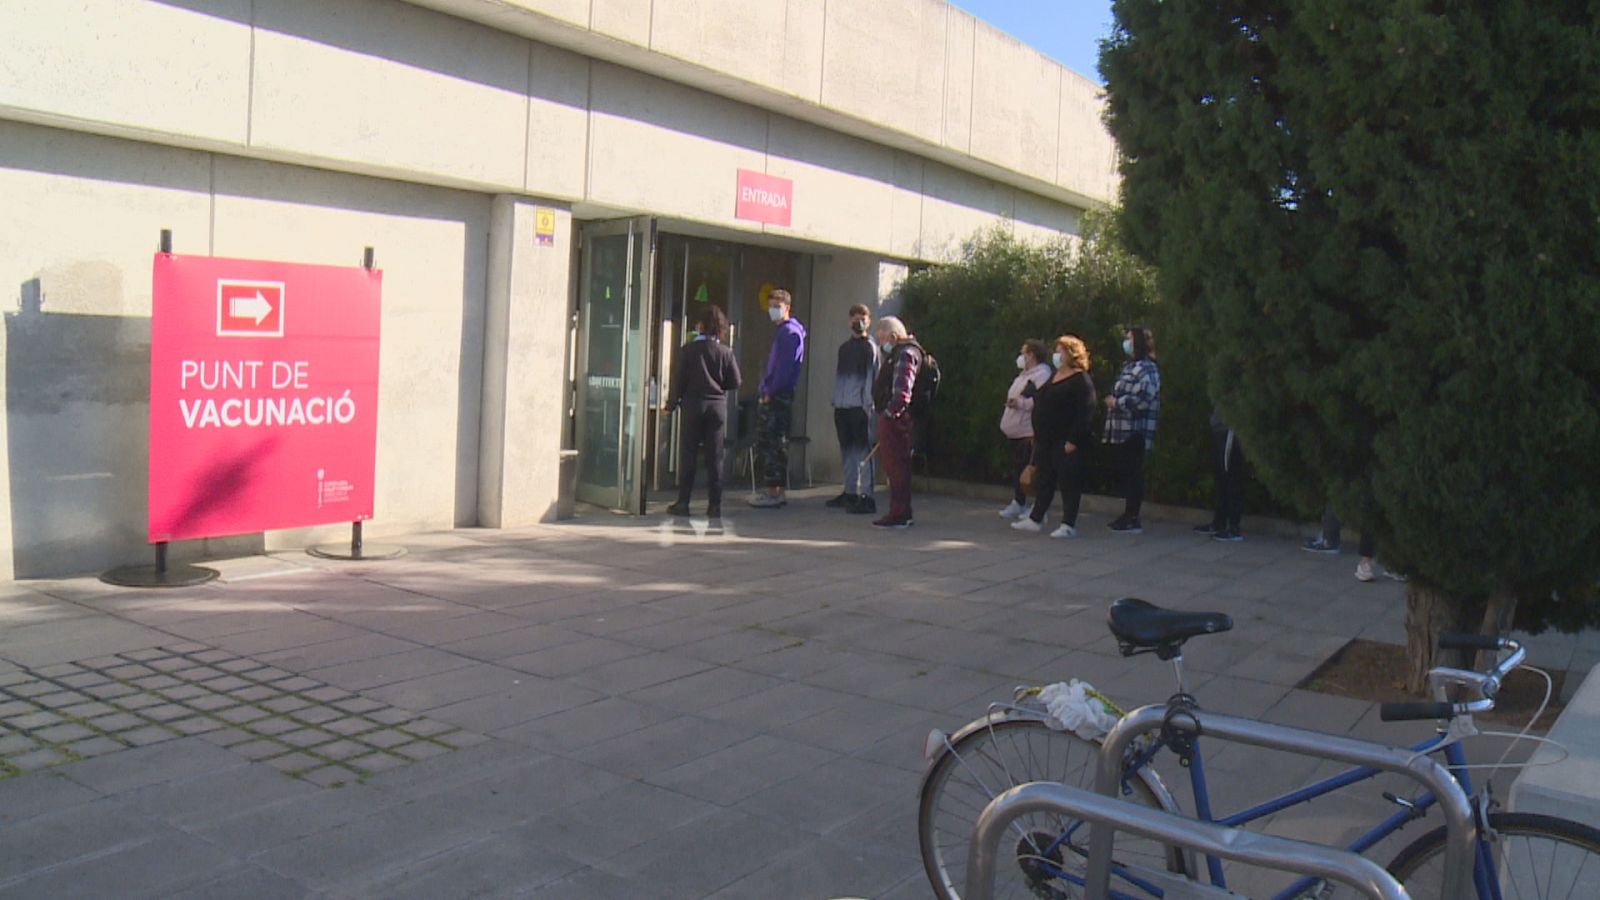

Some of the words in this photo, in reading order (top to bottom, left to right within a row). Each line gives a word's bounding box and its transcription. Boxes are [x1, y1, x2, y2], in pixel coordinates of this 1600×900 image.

[742, 186, 788, 209] ENTRADA
[181, 360, 264, 390] PUNT
[271, 361, 309, 389] DE
[179, 389, 356, 429] VACUNACIÓ
